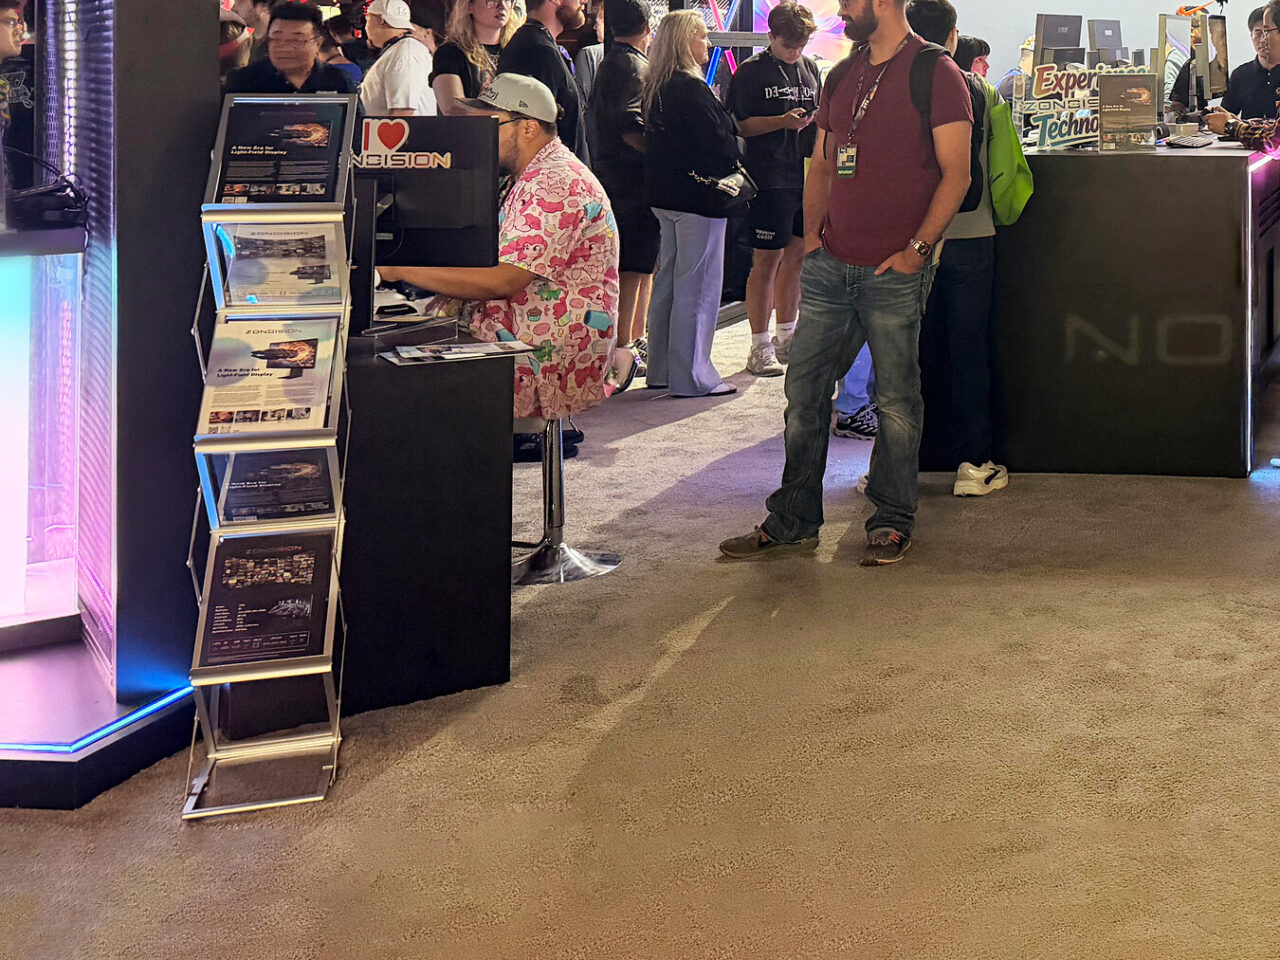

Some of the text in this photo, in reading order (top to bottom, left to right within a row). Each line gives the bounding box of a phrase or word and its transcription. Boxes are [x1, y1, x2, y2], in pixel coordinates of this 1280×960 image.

[1025, 99, 1099, 112] ZONDIS
[364, 122, 370, 150] I
[1032, 112, 1099, 146] Techno
[352, 154, 450, 167] NDISION
